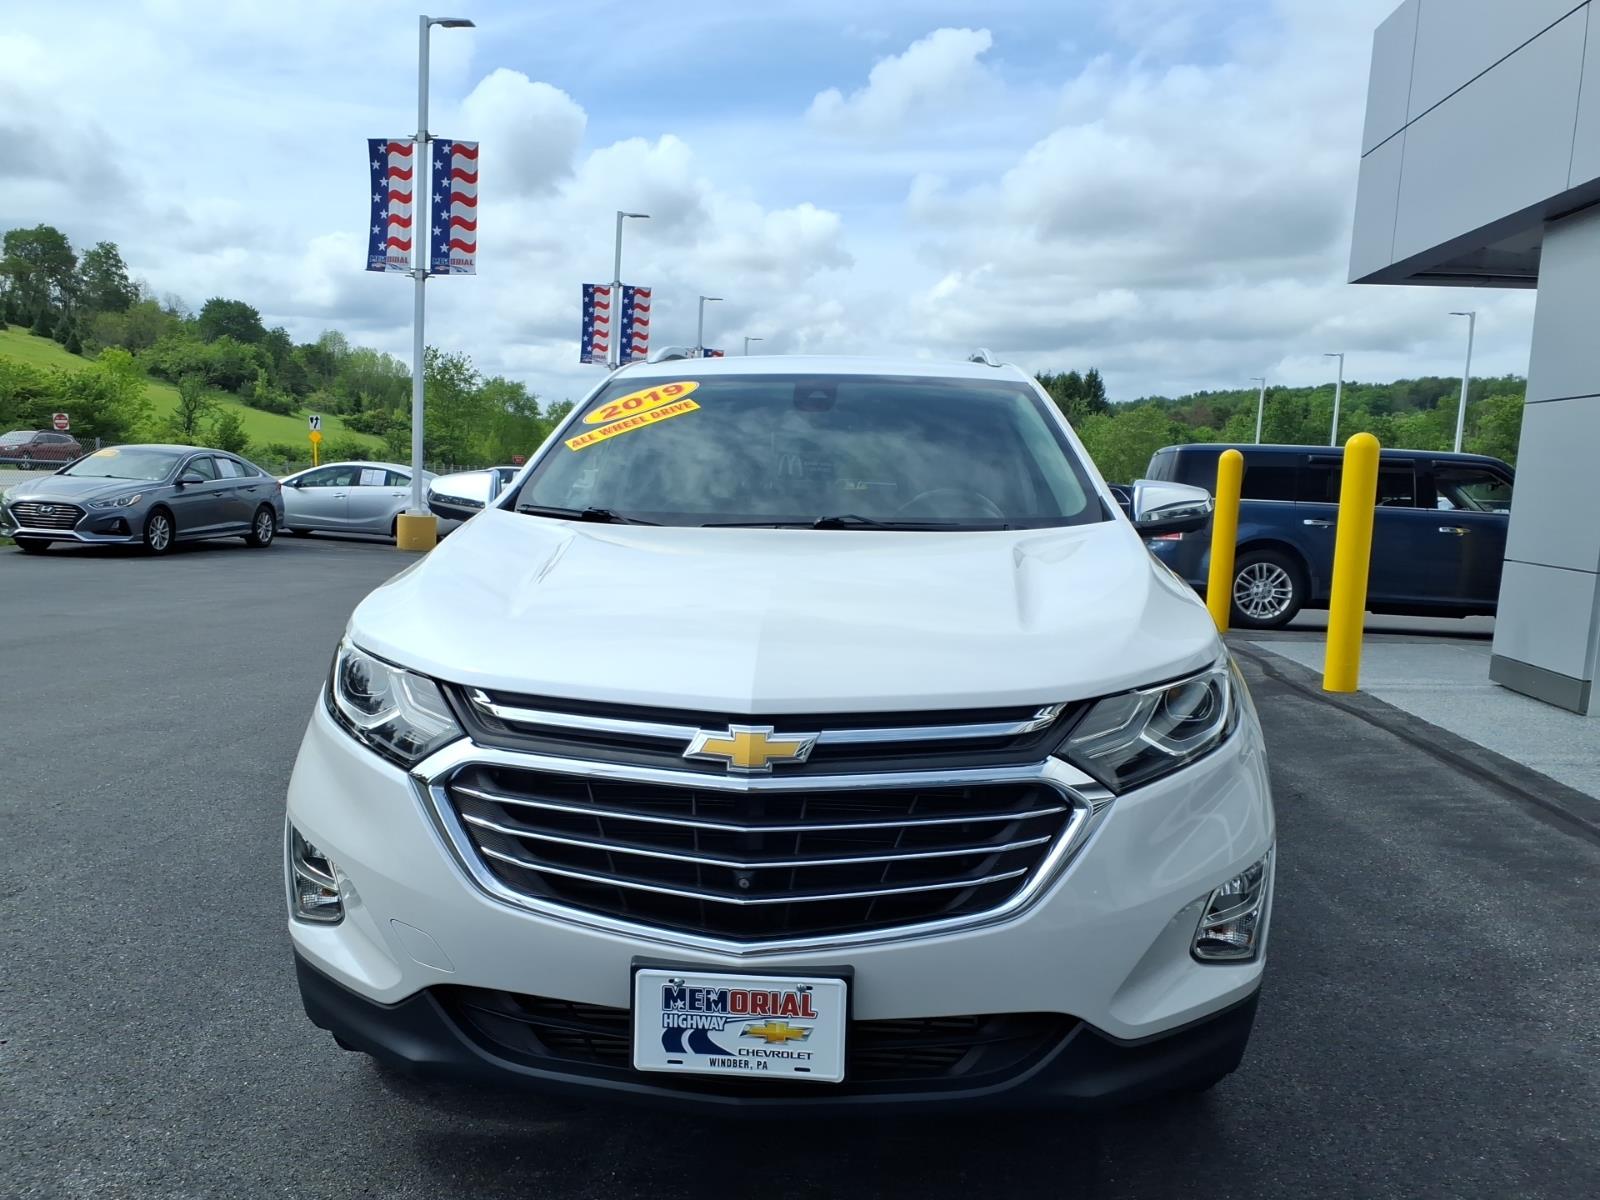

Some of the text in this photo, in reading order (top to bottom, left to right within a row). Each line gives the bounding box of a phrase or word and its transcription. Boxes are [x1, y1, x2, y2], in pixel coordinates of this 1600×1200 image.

[600, 384, 683, 419] 2019
[571, 401, 694, 448] ALL WHEEL DRIVE
[661, 985, 818, 1019] MEMORIAL
[662, 1013, 727, 1031] HIGHWAY
[709, 1057, 768, 1070] WINDBER, PA
[738, 1048, 813, 1060] CHEVROLET
